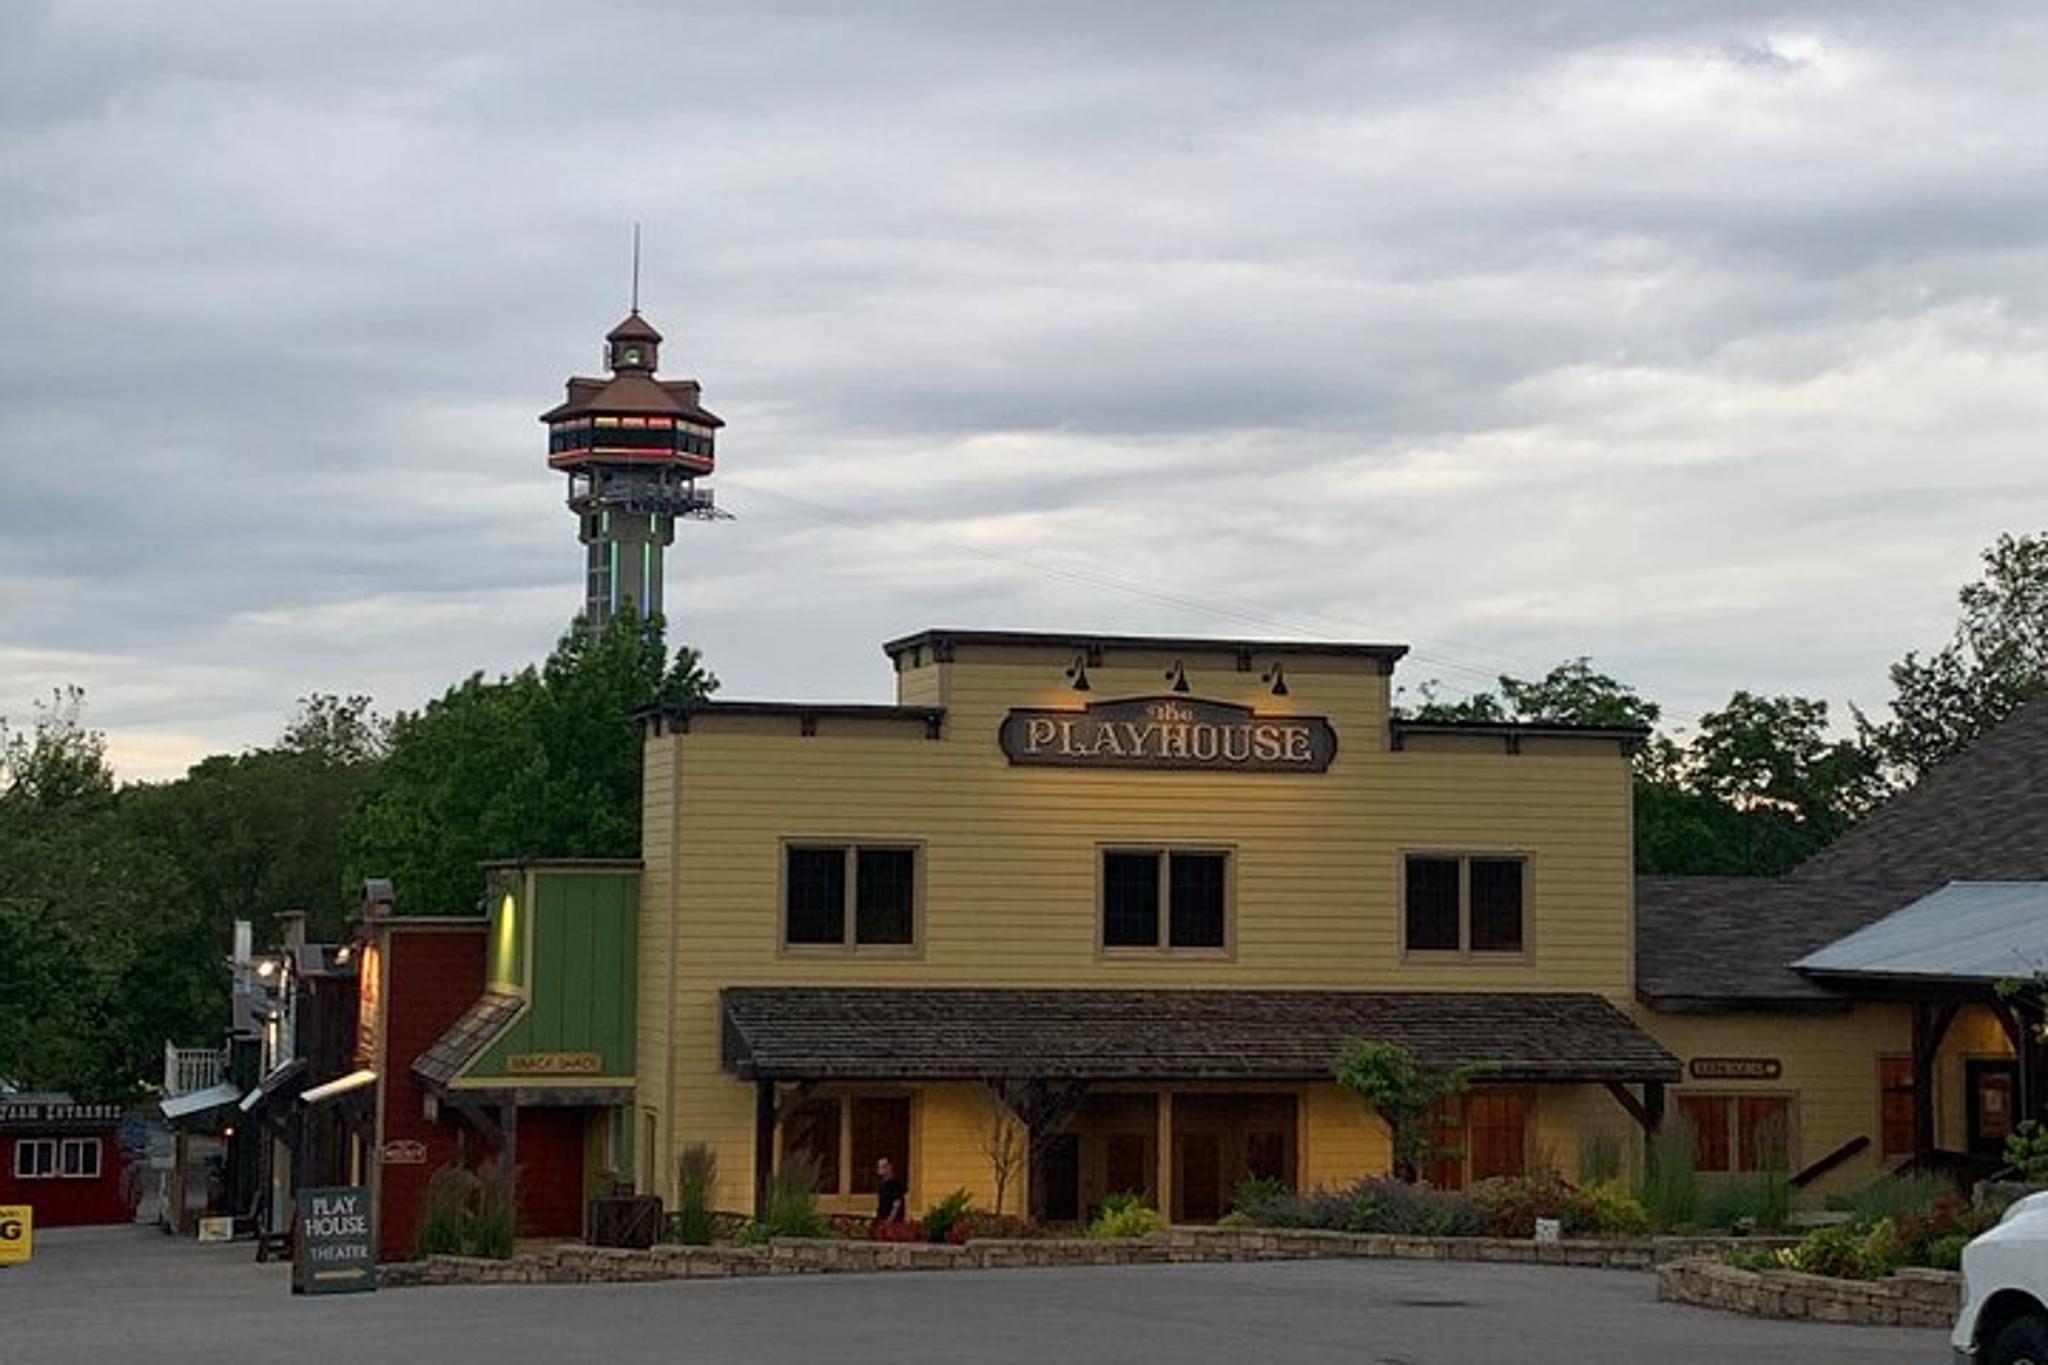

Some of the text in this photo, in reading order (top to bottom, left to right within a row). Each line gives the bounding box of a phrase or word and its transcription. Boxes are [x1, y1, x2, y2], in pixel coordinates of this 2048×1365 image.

[1024, 718, 1312, 761] PLAYHOUSE
[312, 1196, 357, 1215] PLAY
[0, 1220, 22, 1240] G
[304, 1215, 368, 1237] HOUSE
[310, 1245, 368, 1261] THEATER
